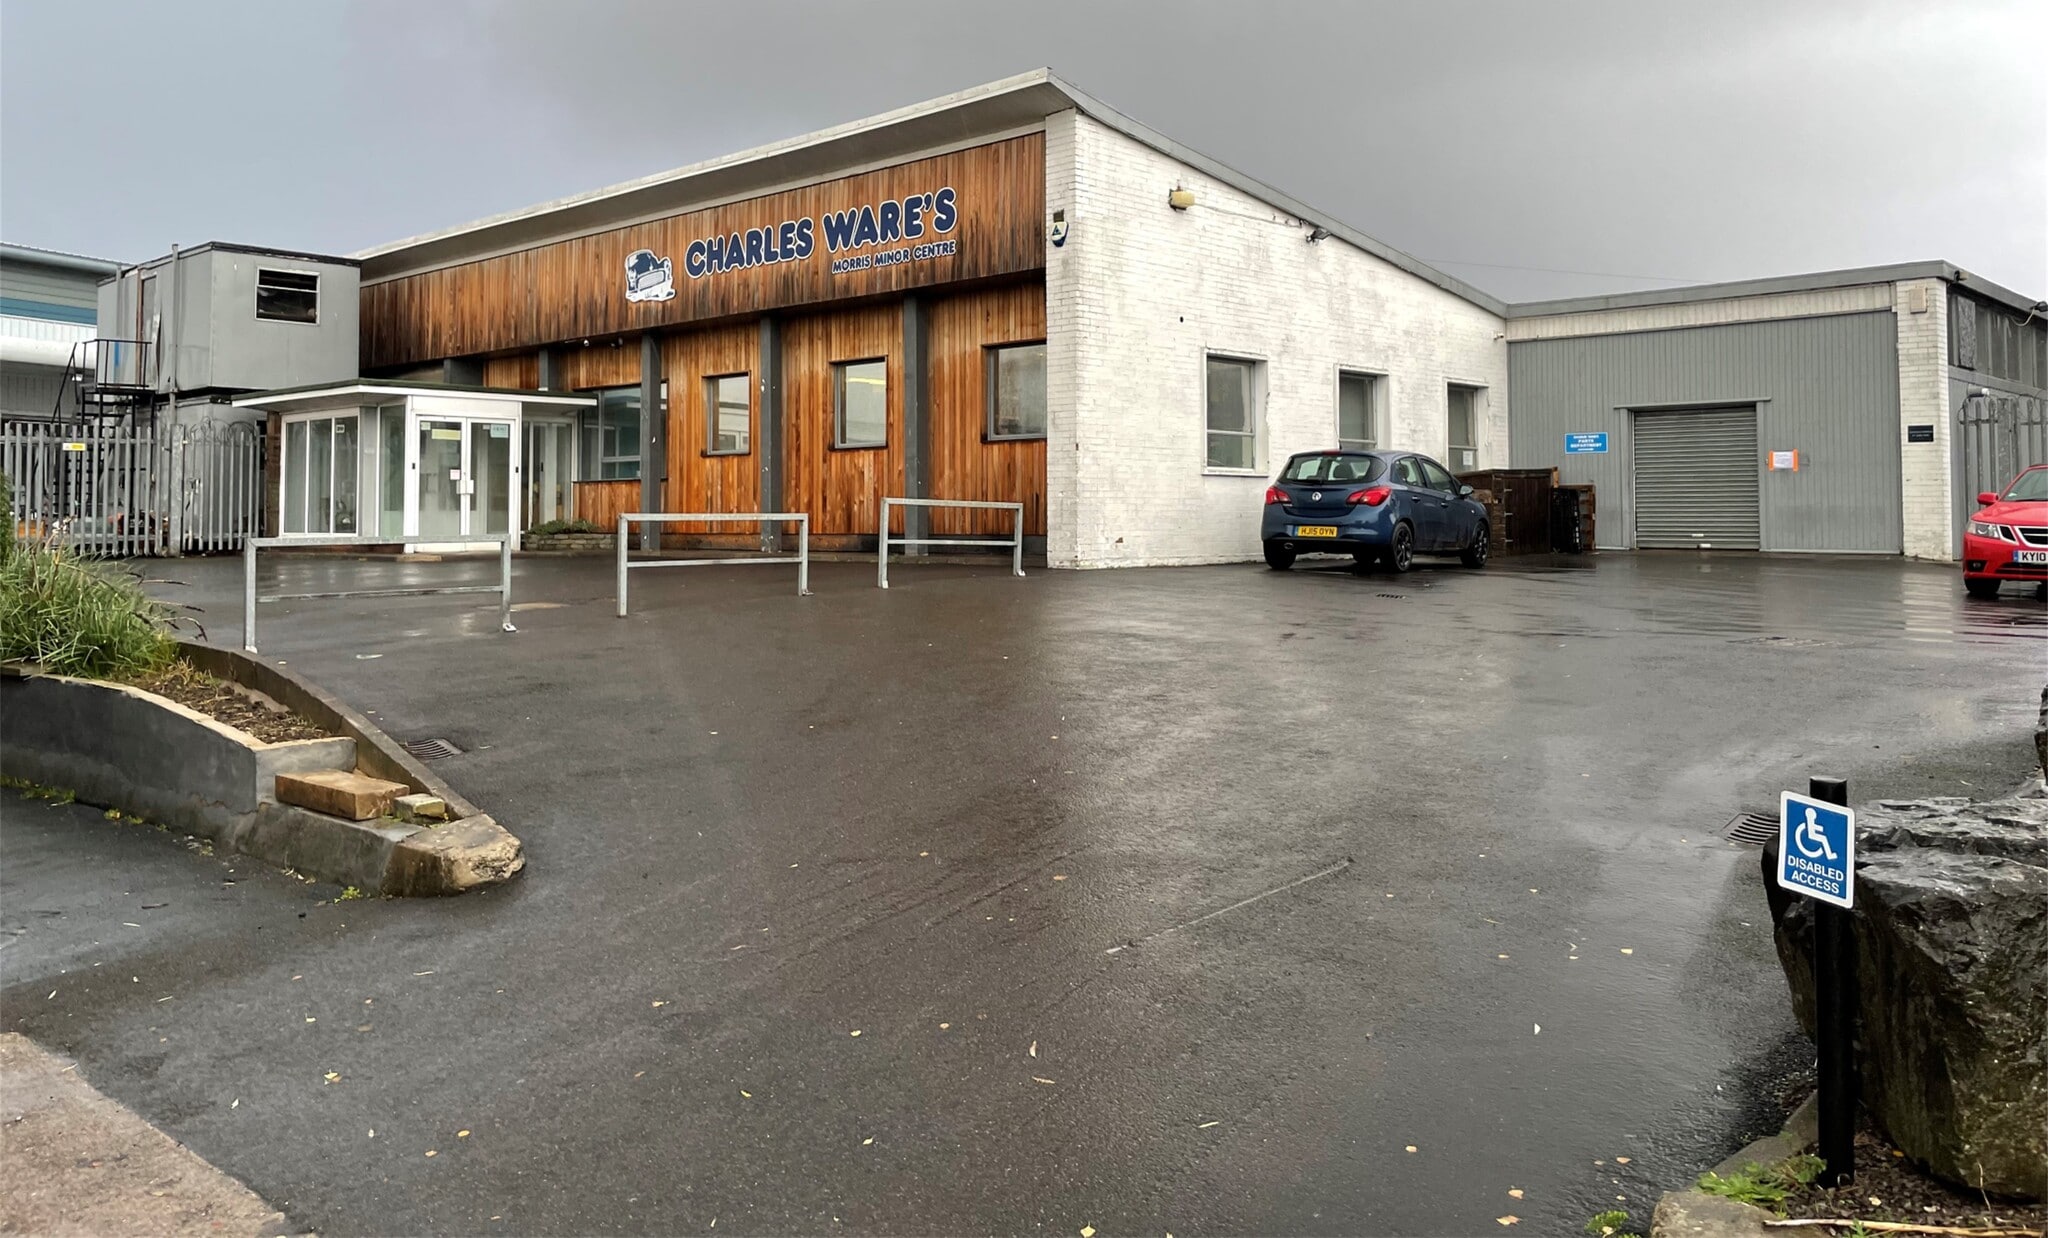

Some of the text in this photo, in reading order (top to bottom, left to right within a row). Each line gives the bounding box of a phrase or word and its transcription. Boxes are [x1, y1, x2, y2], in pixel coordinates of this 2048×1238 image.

[685, 187, 957, 279] CHARLES WARE'S
[832, 240, 957, 274] MORRIS MINOR CENTRE
[2021, 551, 2047, 562] KY10
[1788, 855, 1843, 881] DISABLED
[1791, 870, 1840, 894] ACCESS
